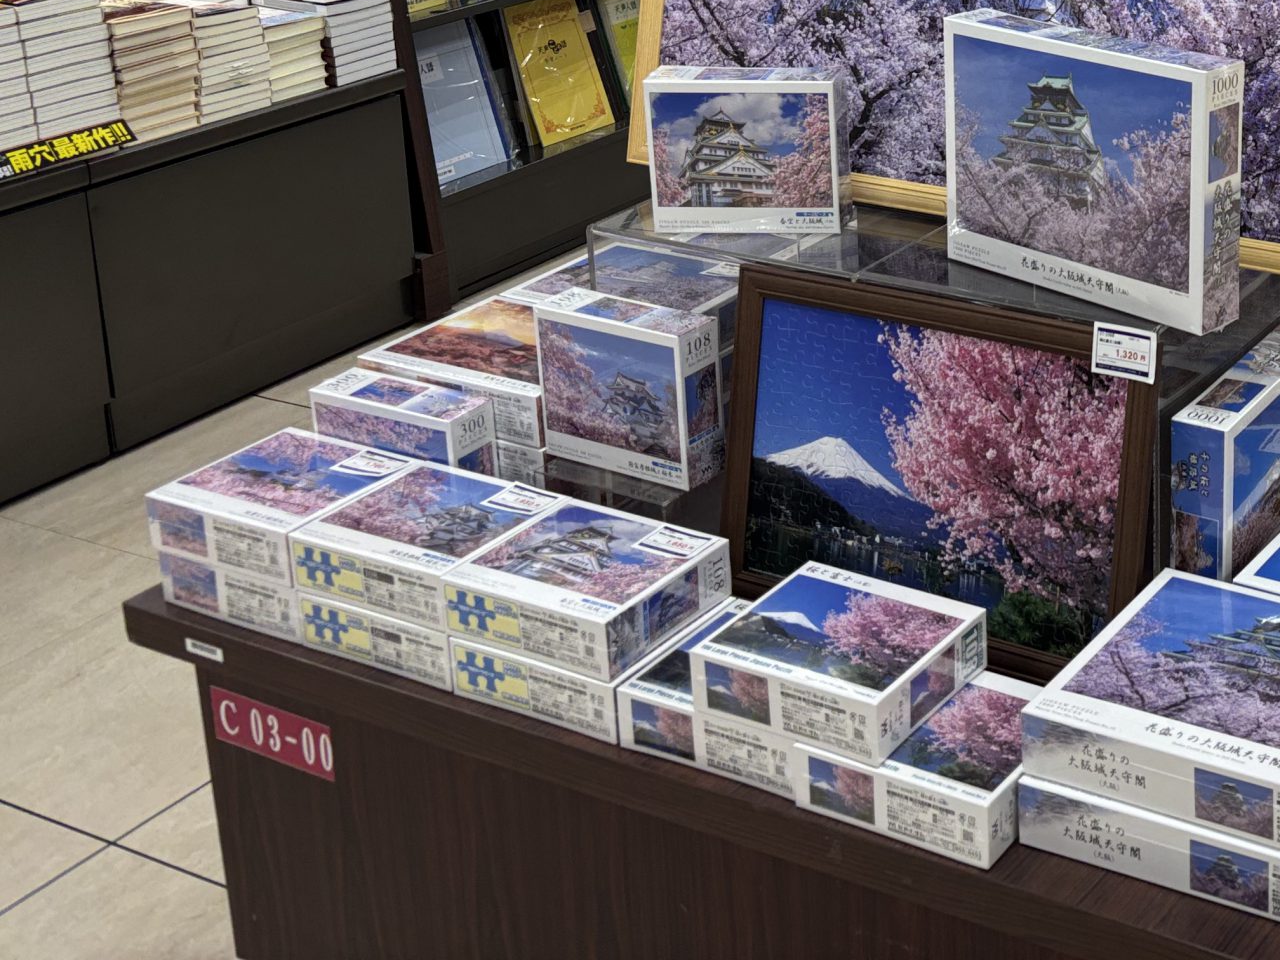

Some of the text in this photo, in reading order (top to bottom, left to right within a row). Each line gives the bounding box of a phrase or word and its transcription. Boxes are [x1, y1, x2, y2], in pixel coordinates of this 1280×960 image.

[1211, 72, 1240, 96] 1000
[686, 331, 713, 356] 108
[459, 413, 487, 440] 300
[219, 699, 334, 773] C 03-00
[1080, 742, 1130, 766] 花盛りの
[1067, 754, 1147, 790] 大阪城天守閣
[1076, 814, 1126, 838] 花盛りの
[1062, 825, 1143, 862] 大阪城天守閣
